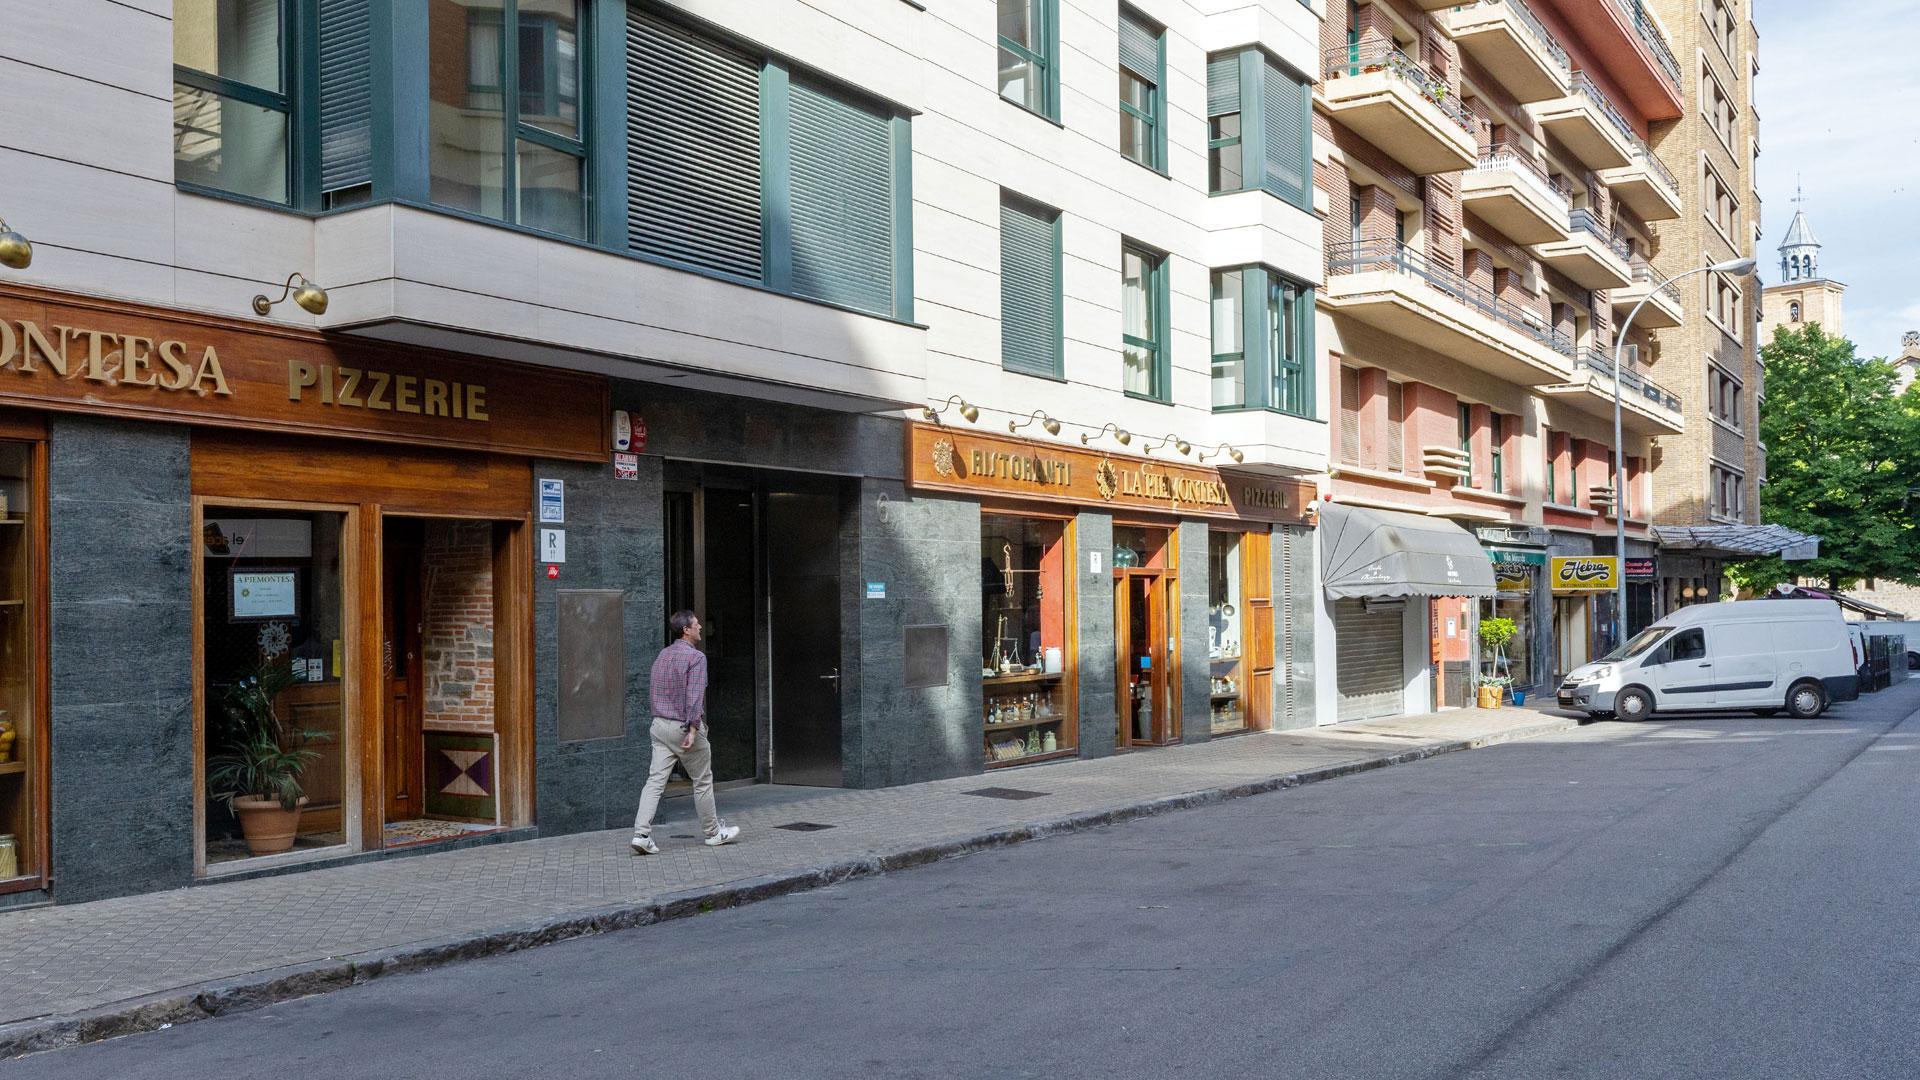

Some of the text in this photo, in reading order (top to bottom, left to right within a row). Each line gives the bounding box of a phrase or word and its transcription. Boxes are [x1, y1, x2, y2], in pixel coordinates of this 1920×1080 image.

[288, 359, 490, 422] PIZZERIE
[971, 449, 1072, 487] RISTORANTI
[1121, 469, 1229, 506] LA PIEMONTESA
[549, 532, 557, 549] R
[1559, 560, 1610, 581] Hebra
